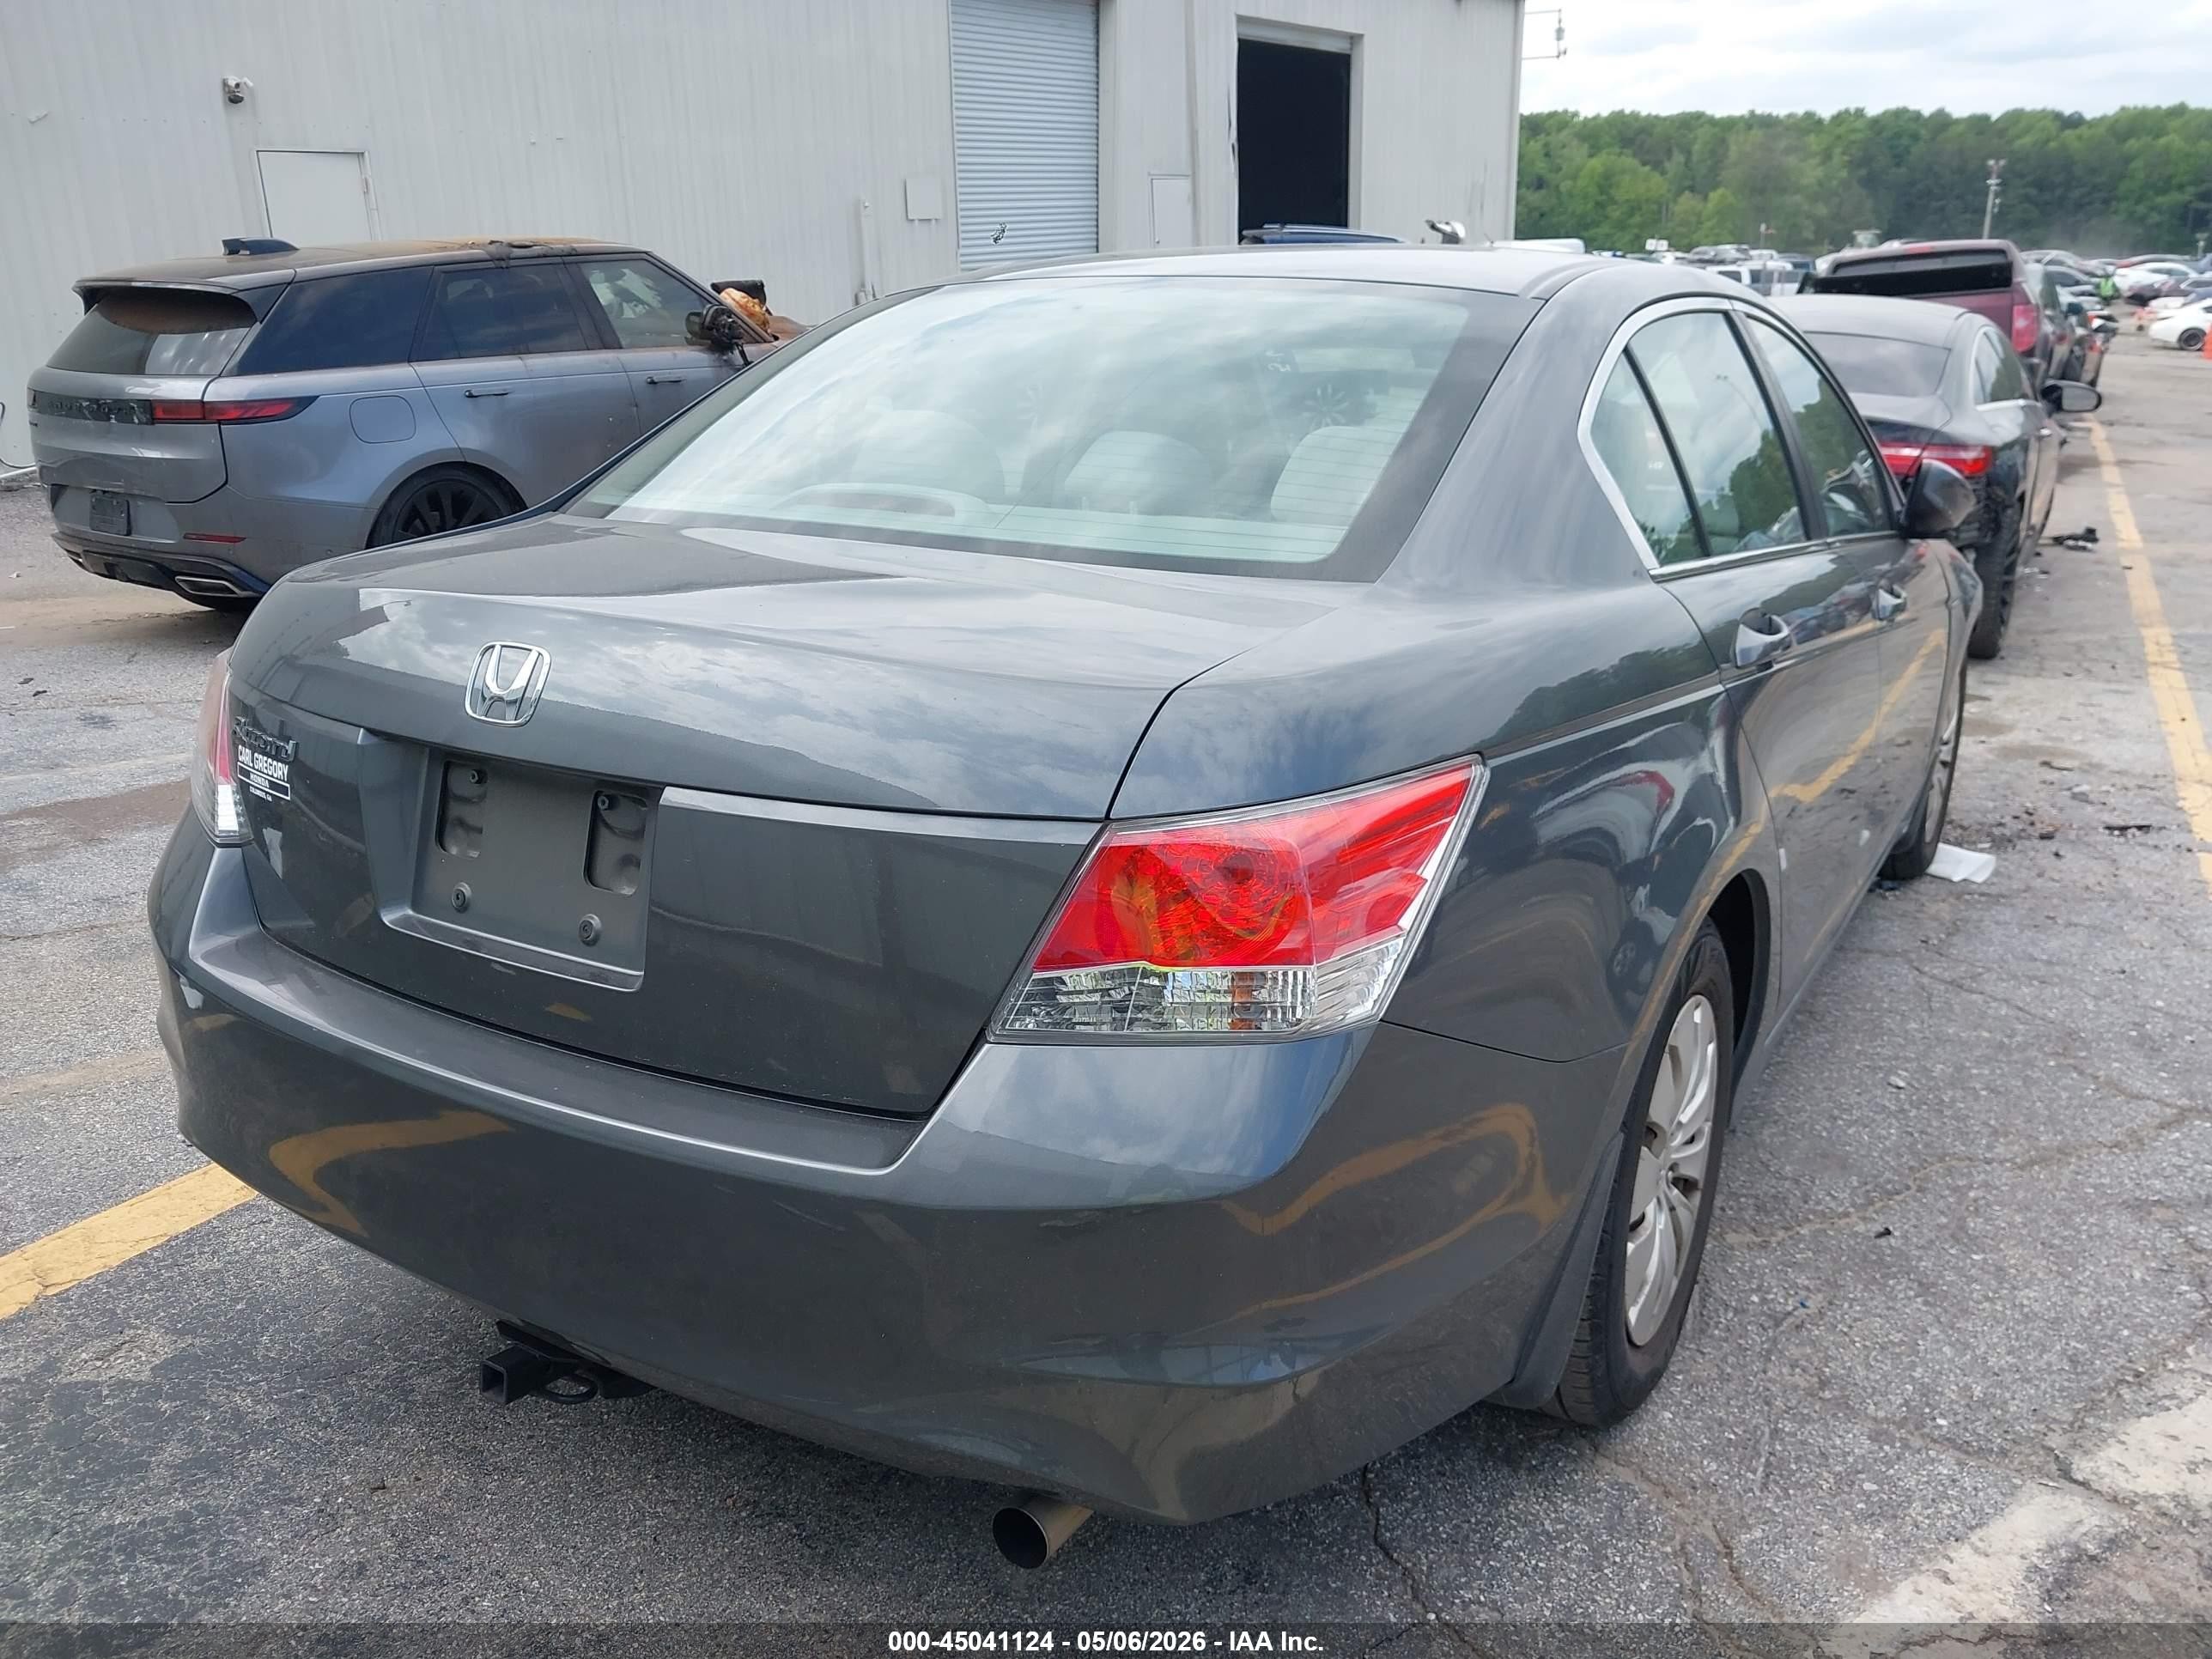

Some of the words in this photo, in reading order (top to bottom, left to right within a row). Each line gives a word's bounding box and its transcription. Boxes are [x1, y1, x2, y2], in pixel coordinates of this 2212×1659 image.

[238, 744, 253, 767] CARL
[253, 752, 289, 782] GREGORY
[249, 772, 270, 788] HONDA
